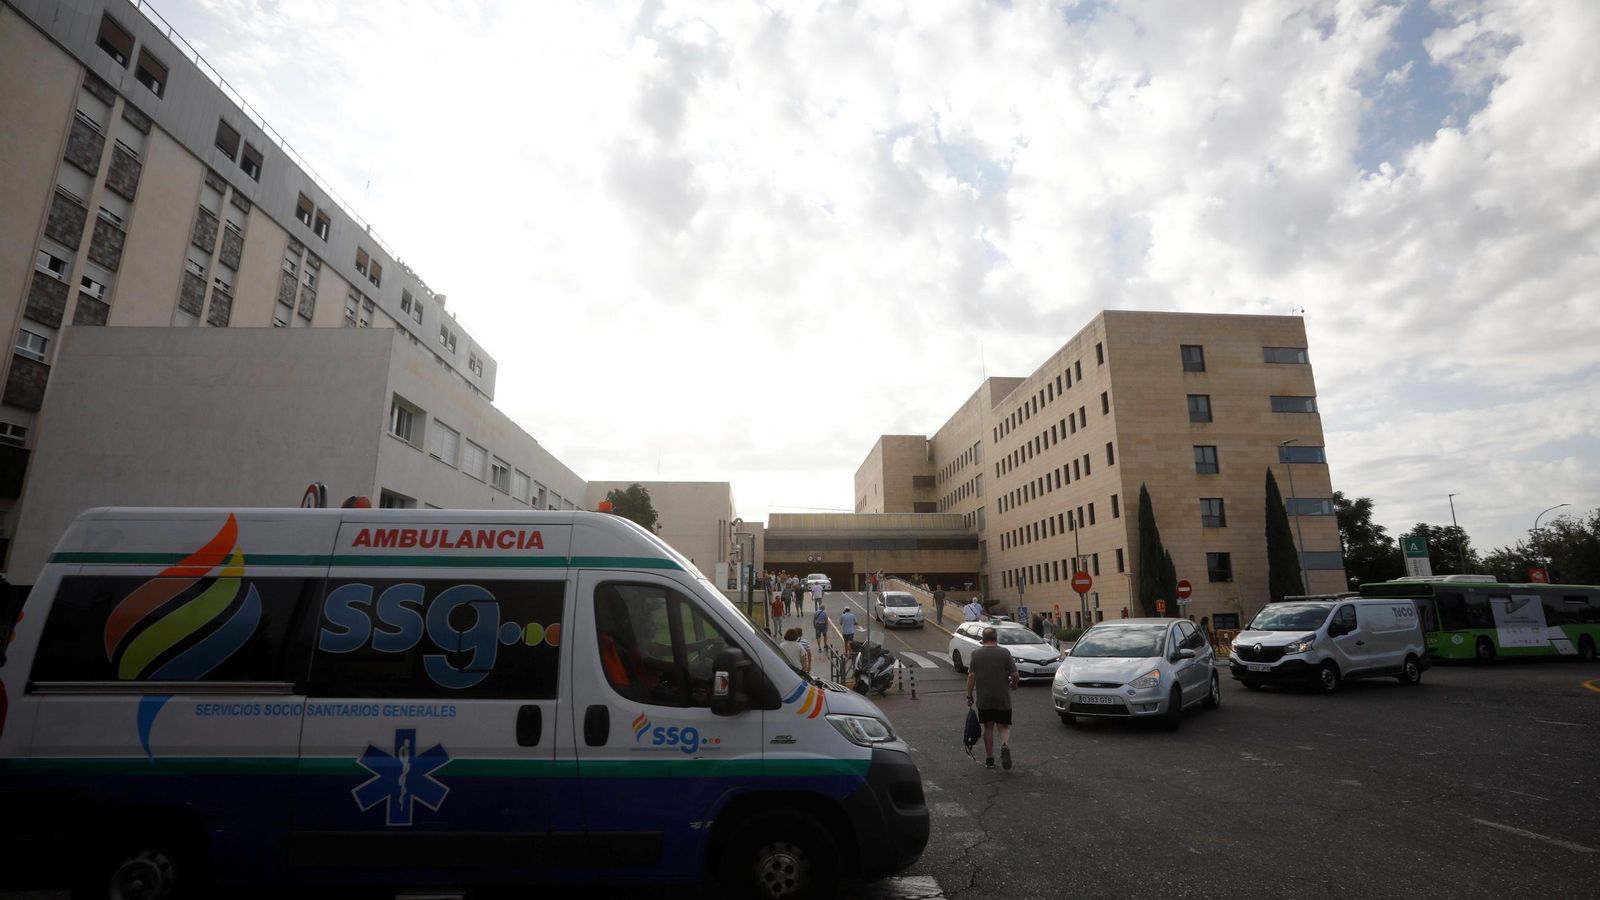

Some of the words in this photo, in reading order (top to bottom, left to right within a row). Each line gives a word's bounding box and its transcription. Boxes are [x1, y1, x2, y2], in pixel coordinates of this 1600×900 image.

[352, 528, 545, 550] AMBULANCIA
[318, 583, 501, 689] ssg
[194, 703, 261, 717] SERVICIOS
[263, 703, 303, 717] SOCIO
[306, 704, 379, 717] SANITARIOS
[382, 704, 457, 718] GENERALES
[652, 726, 699, 754] ssg
